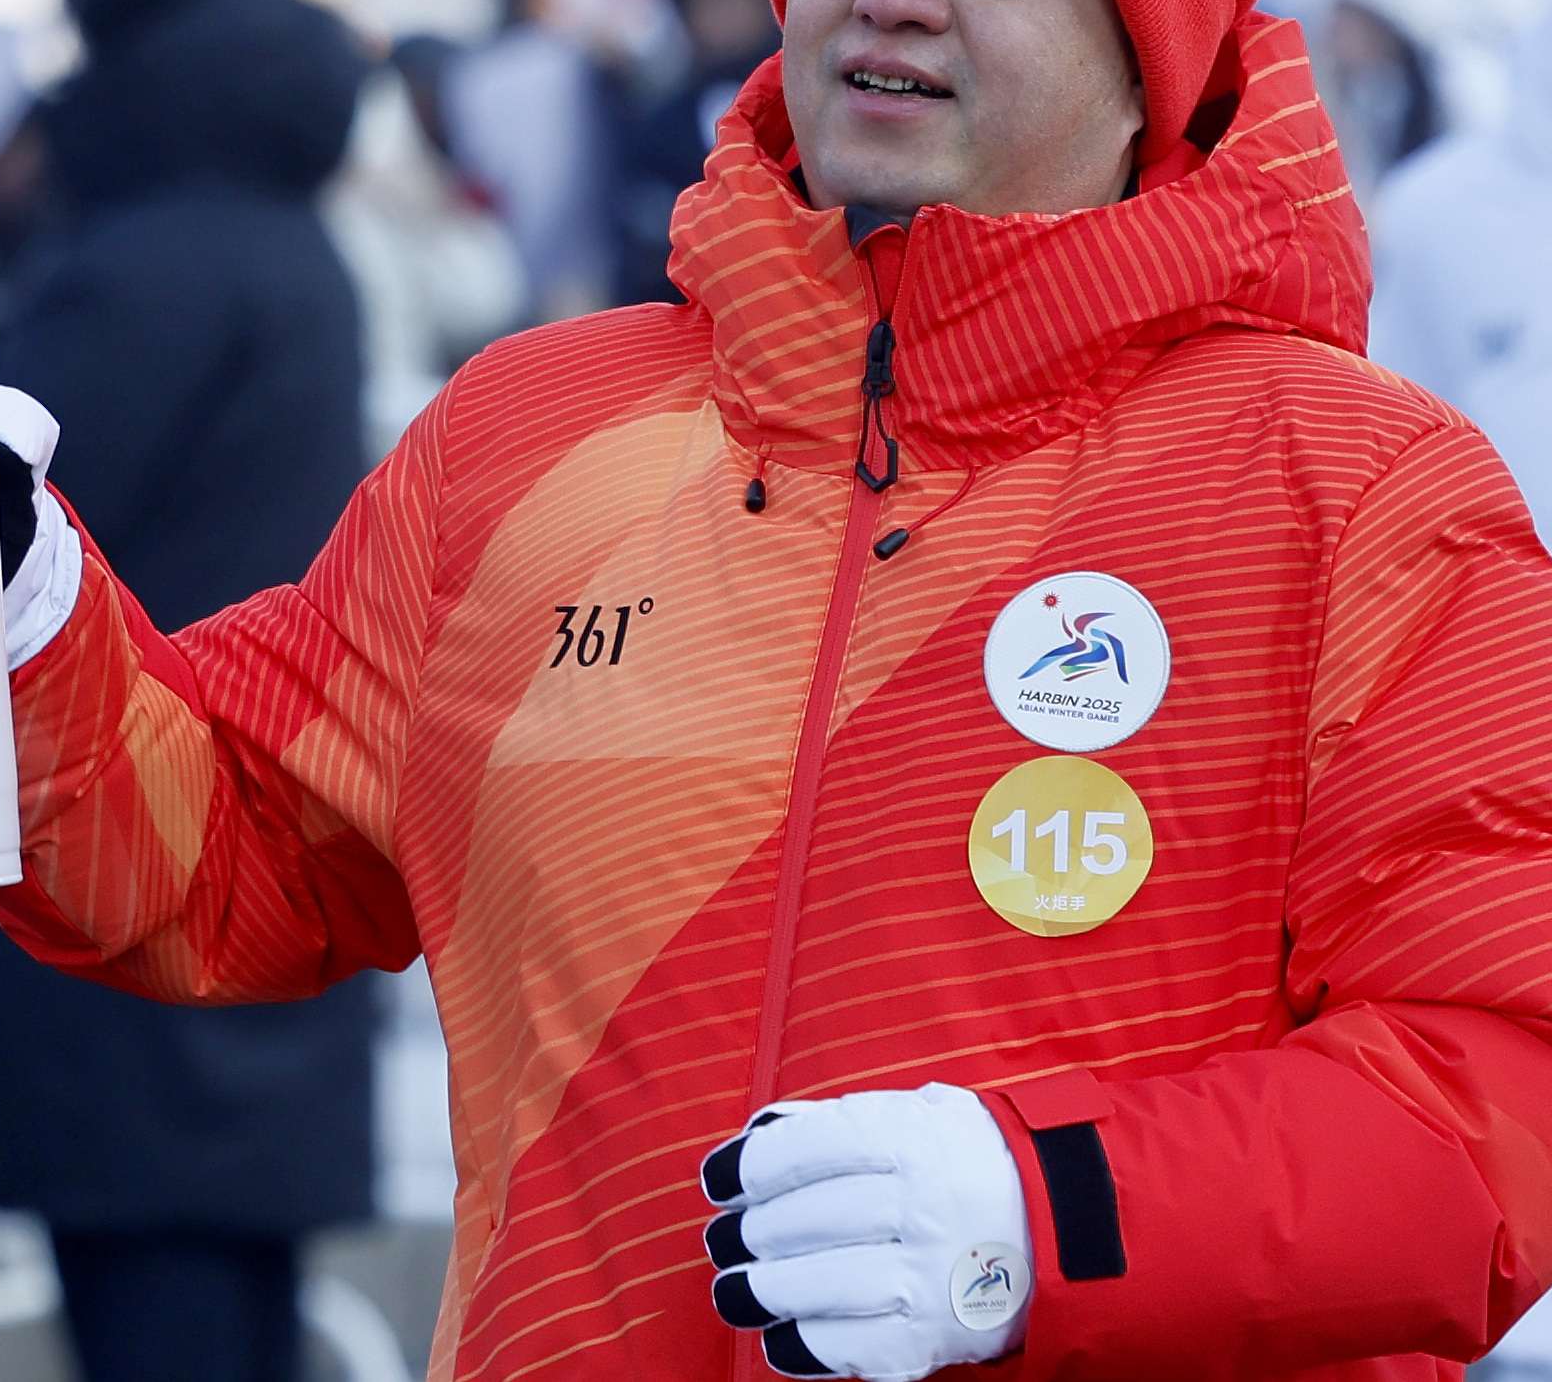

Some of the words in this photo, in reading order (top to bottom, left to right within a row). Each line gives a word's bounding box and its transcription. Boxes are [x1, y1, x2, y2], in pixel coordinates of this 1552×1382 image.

[1018, 689, 1080, 707] HARBIN
[1081, 697, 1122, 714] 2025
[1017, 703, 1046, 714] ASIAN
[1047, 707, 1084, 719] WINTER
[1086, 712, 1120, 723] GAMES
[991, 809, 1128, 875] 115
[1034, 894, 1086, 911] 火炬手
